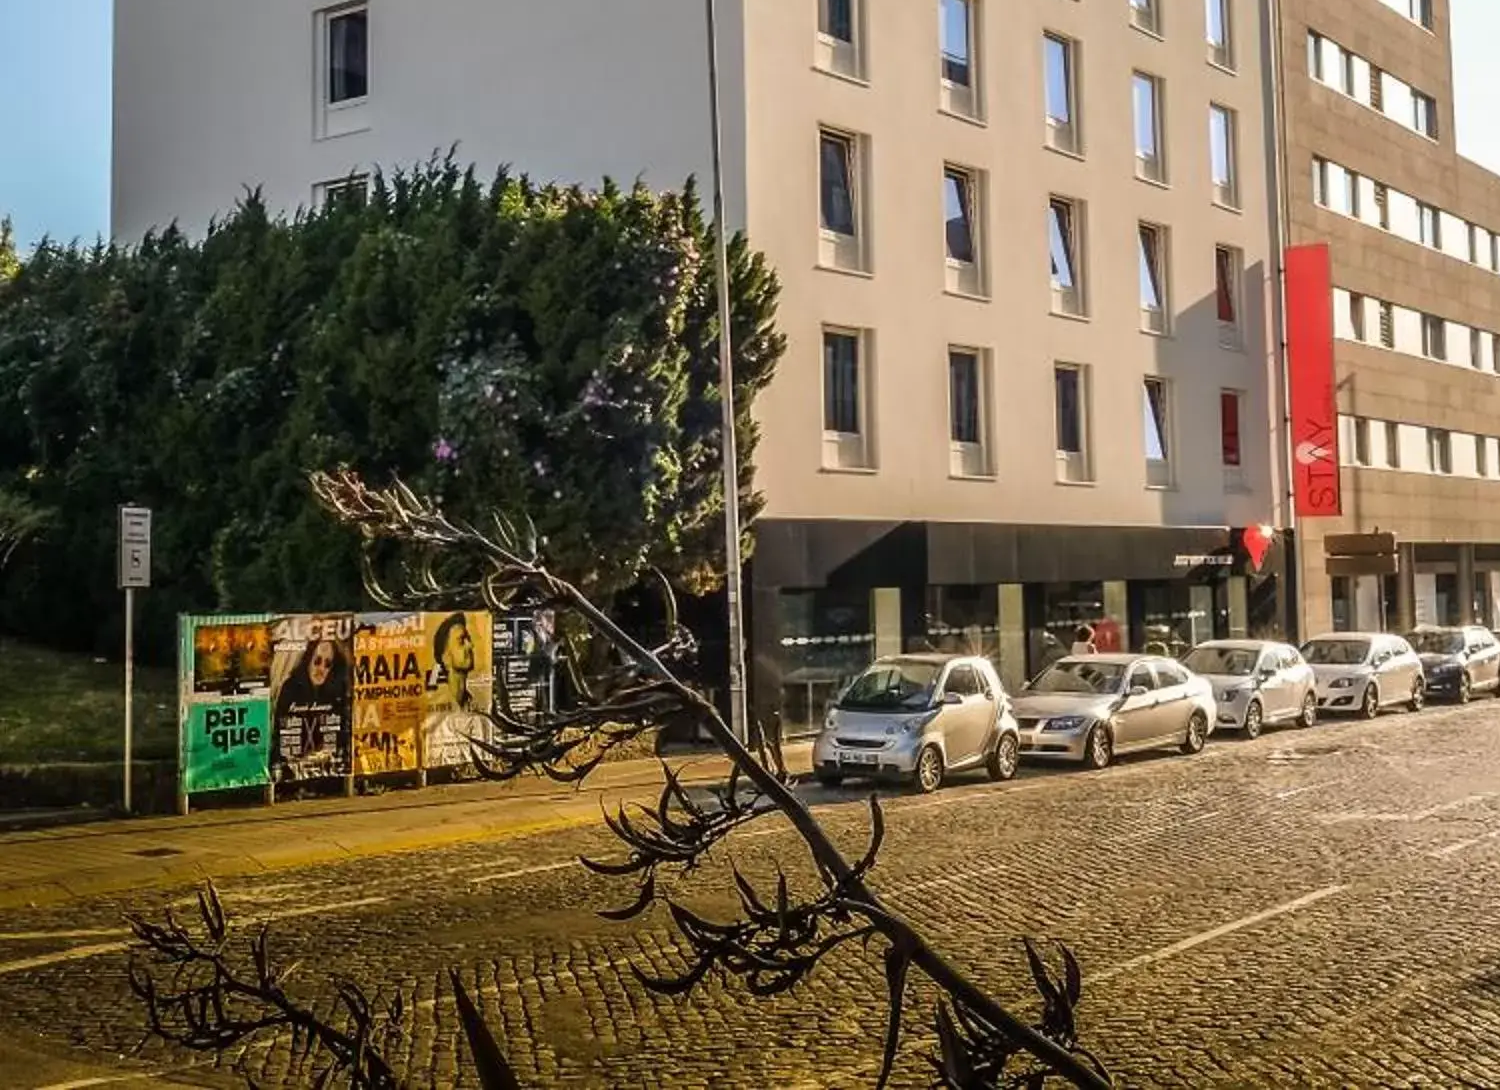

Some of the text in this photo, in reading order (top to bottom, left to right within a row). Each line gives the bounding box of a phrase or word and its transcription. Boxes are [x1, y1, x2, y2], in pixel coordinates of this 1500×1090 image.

[1301, 417, 1337, 509] STAY
[205, 707, 249, 735] par
[211, 727, 261, 754] que
